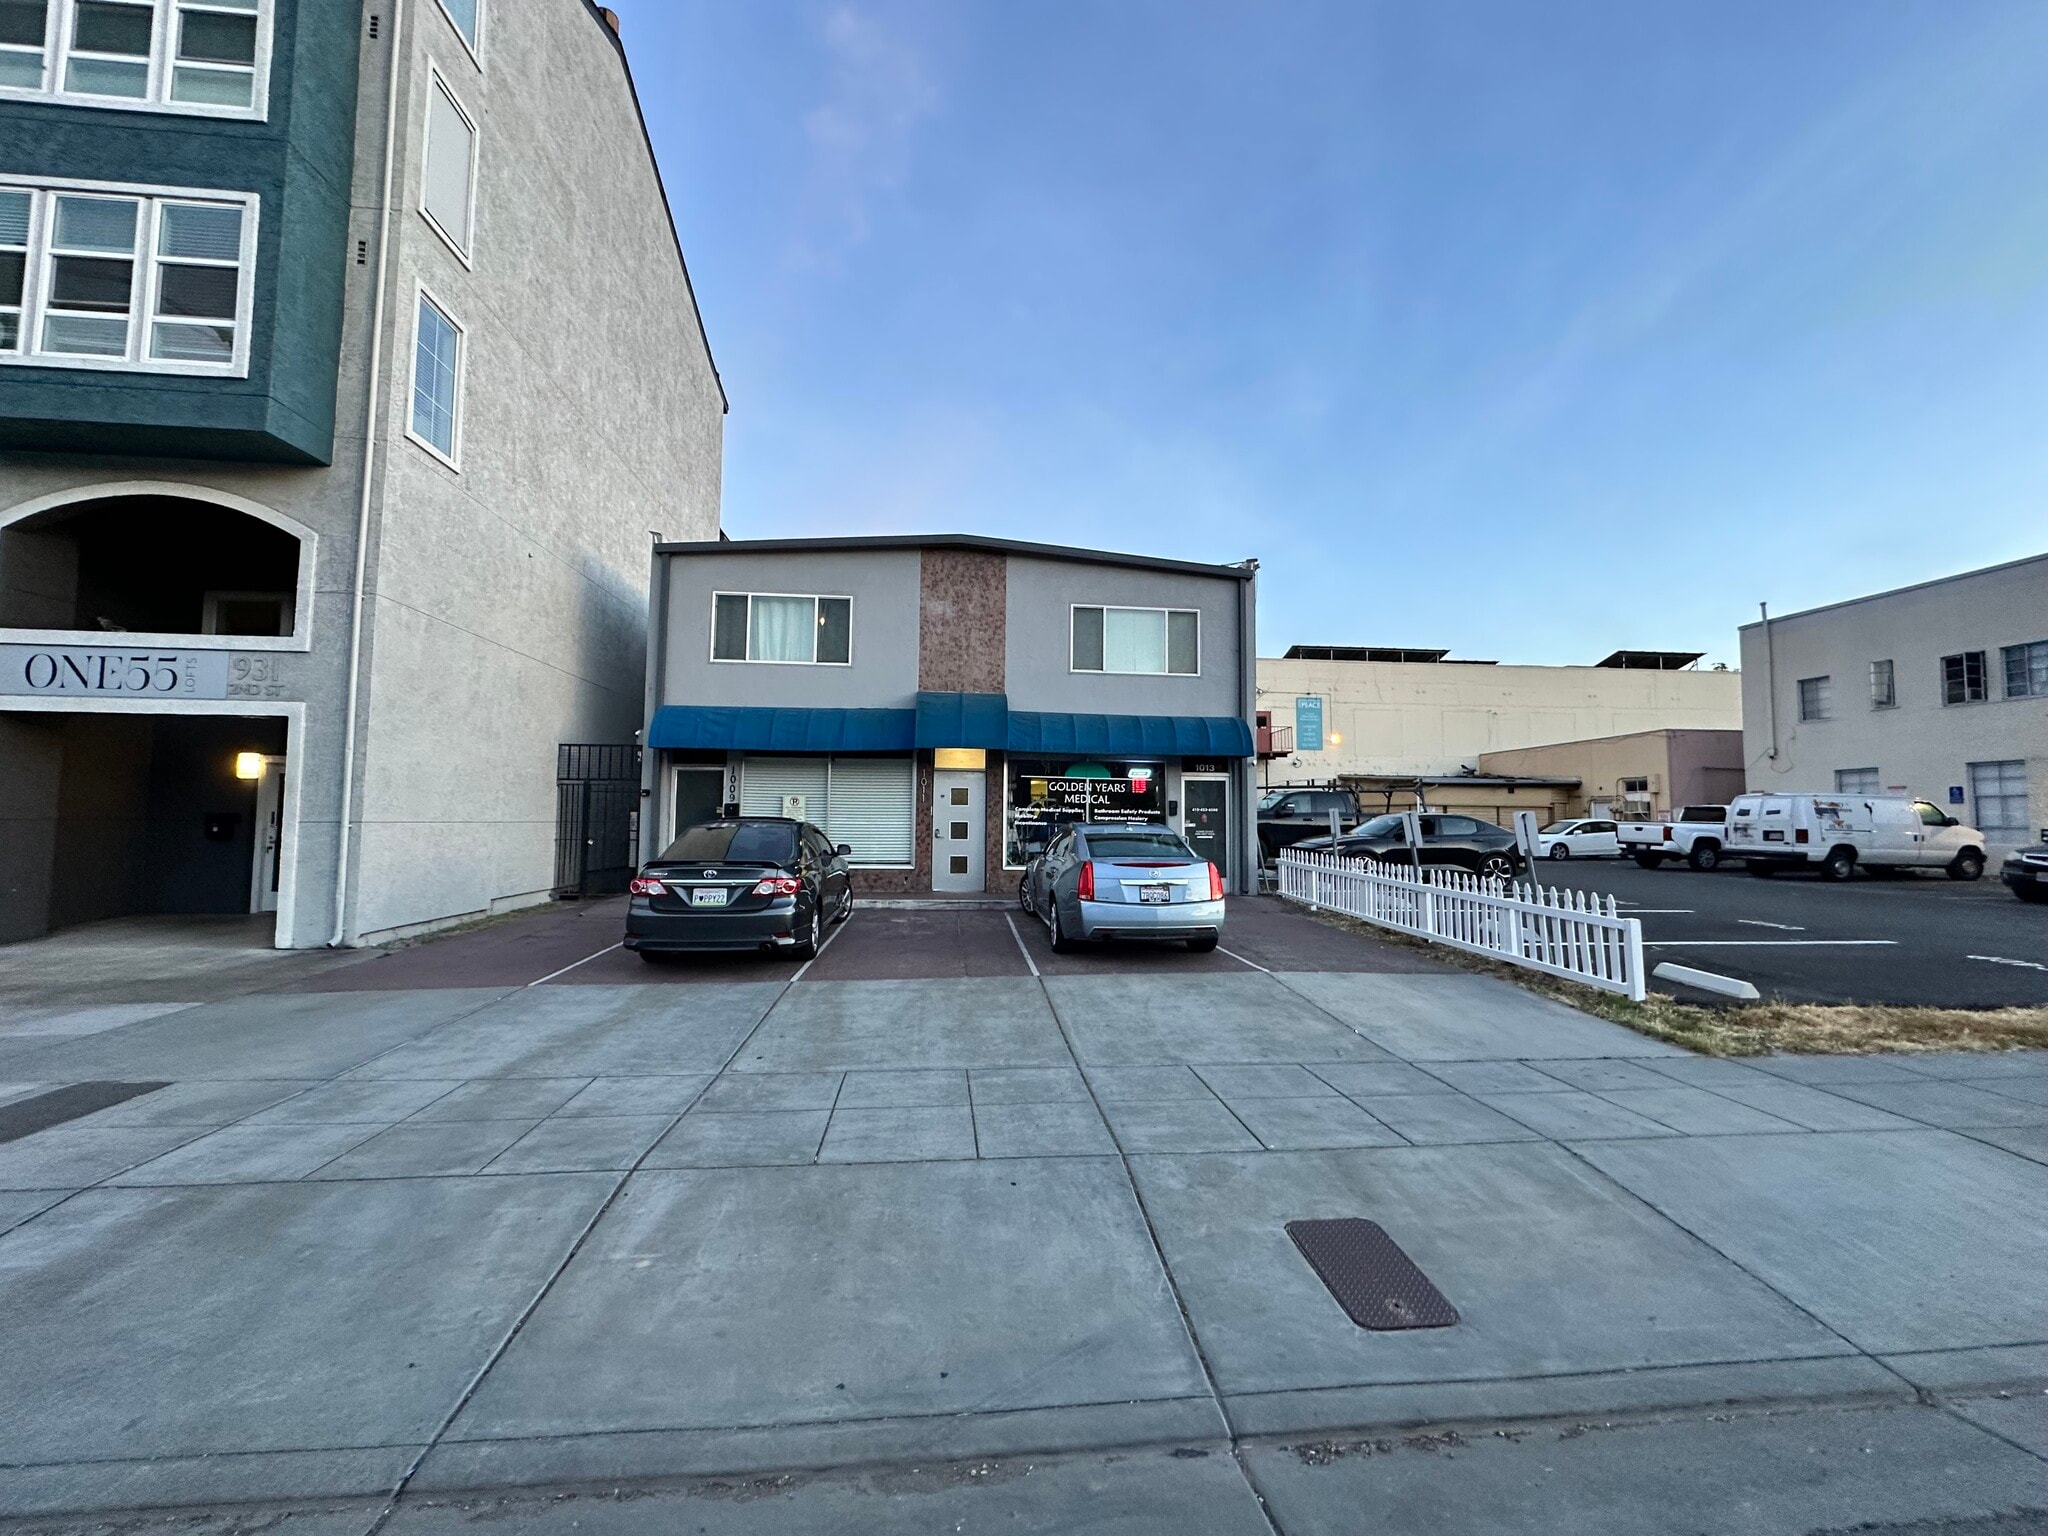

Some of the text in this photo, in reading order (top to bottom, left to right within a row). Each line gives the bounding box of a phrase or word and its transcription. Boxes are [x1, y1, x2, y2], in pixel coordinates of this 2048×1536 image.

[24, 652, 178, 692] ONE55
[184, 656, 197, 693] LOFTS
[233, 656, 279, 682] 931
[228, 683, 285, 697] 2ND ST
[1195, 764, 1216, 772] 1013
[729, 765, 737, 802] 1009
[1048, 781, 1093, 792] GOLDEN
[1095, 783, 1126, 793] YEARS
[1064, 794, 1110, 805] MEDICAL
